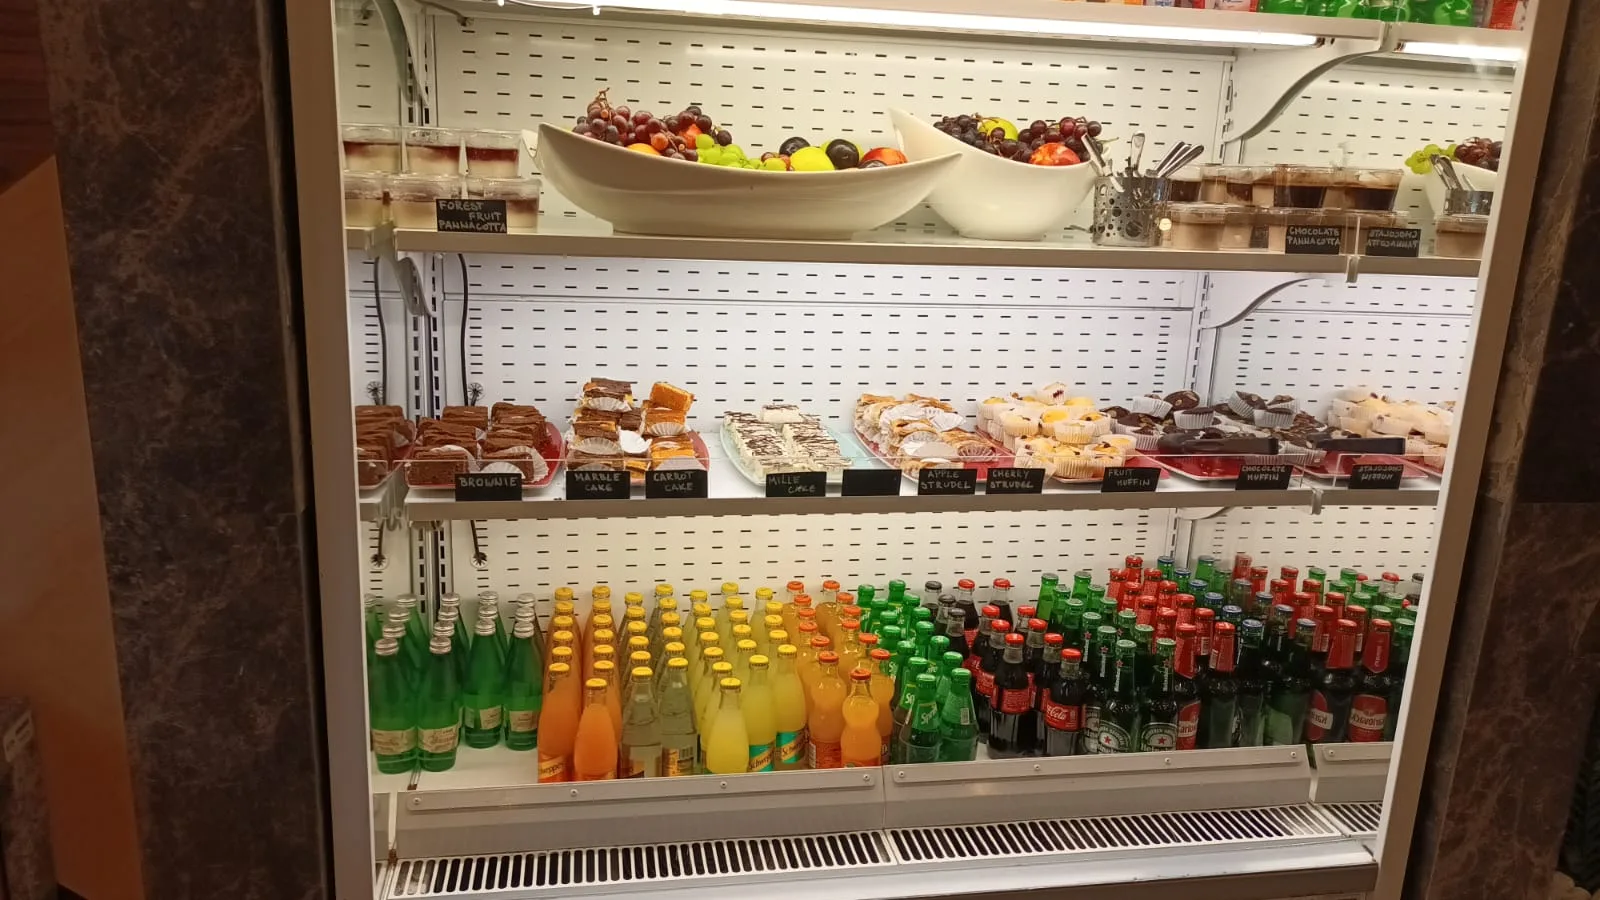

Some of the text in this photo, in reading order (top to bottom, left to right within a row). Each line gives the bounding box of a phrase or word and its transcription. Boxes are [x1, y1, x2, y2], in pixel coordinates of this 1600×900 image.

[439, 201, 484, 211] FOREST
[468, 211, 502, 221] FRUIT
[439, 219, 507, 231] PANNACOTTA
[1289, 226, 1340, 236] CHOCOLATE
[927, 469, 960, 479] APPLE
[992, 469, 1030, 479] CHERRY
[1108, 468, 1135, 477] FRUIT
[1241, 465, 1287, 473] CHOCOLATE
[574, 472, 622, 482] MARBLE
[653, 470, 695, 482] CARROT
[768, 473, 801, 486] MILLE
[1247, 472, 1280, 481] MUFFIN
[458, 476, 518, 488] BROWNIE
[664, 482, 694, 492] CAKE
[920, 480, 972, 490] STRUDEL
[990, 480, 1034, 489] STRUDEL
[1116, 478, 1151, 487] MUFFIN
